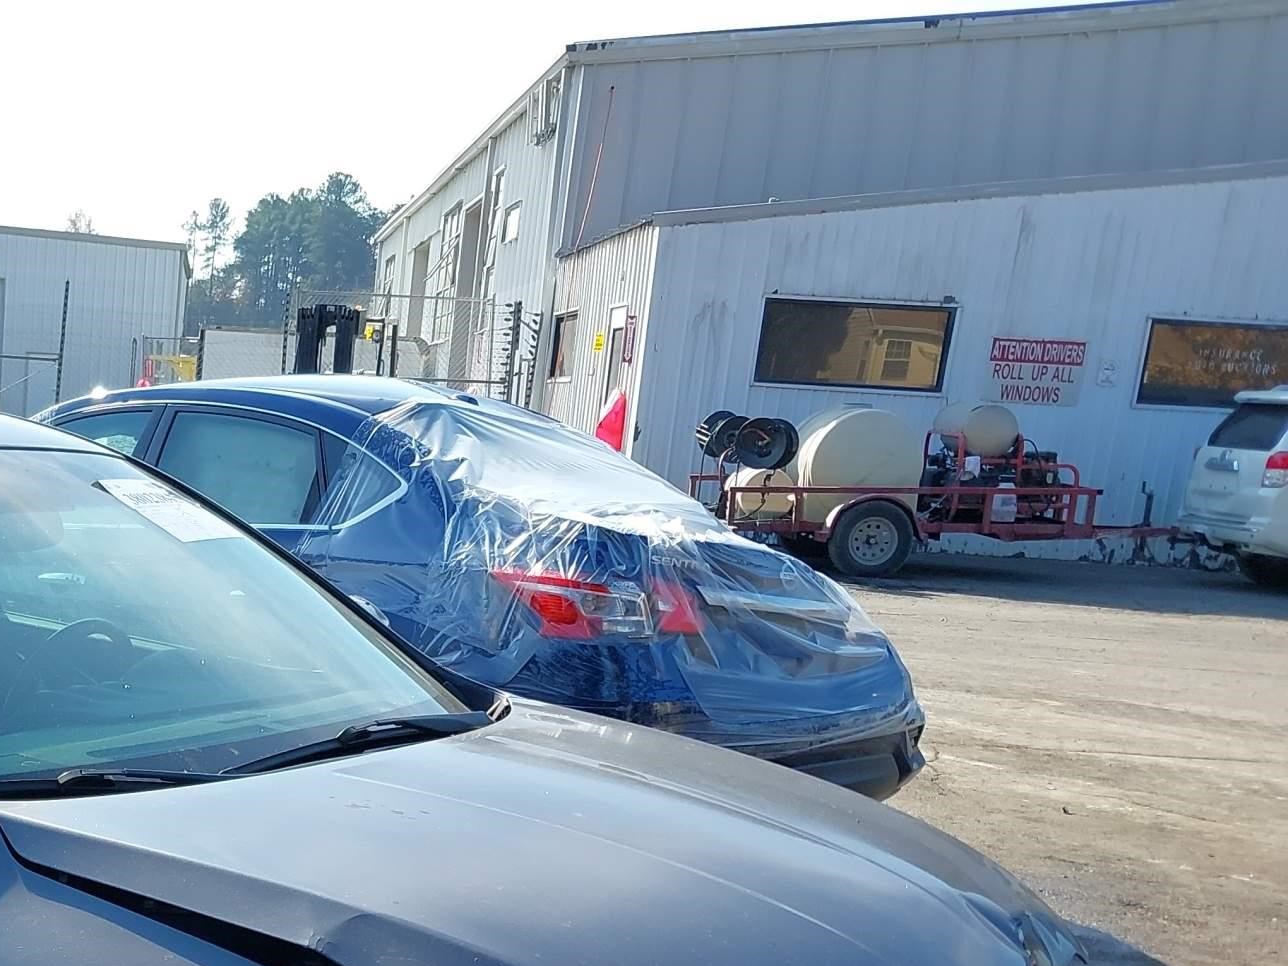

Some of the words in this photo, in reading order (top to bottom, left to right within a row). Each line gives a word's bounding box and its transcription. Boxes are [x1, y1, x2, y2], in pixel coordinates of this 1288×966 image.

[992, 340, 1043, 361] ATTENTION
[1044, 342, 1084, 363] DRIVERS
[993, 364, 1024, 380] ROLL
[1032, 365, 1048, 381] UP
[1051, 367, 1074, 383] ALL
[1000, 384, 1060, 403] WINDOWS
